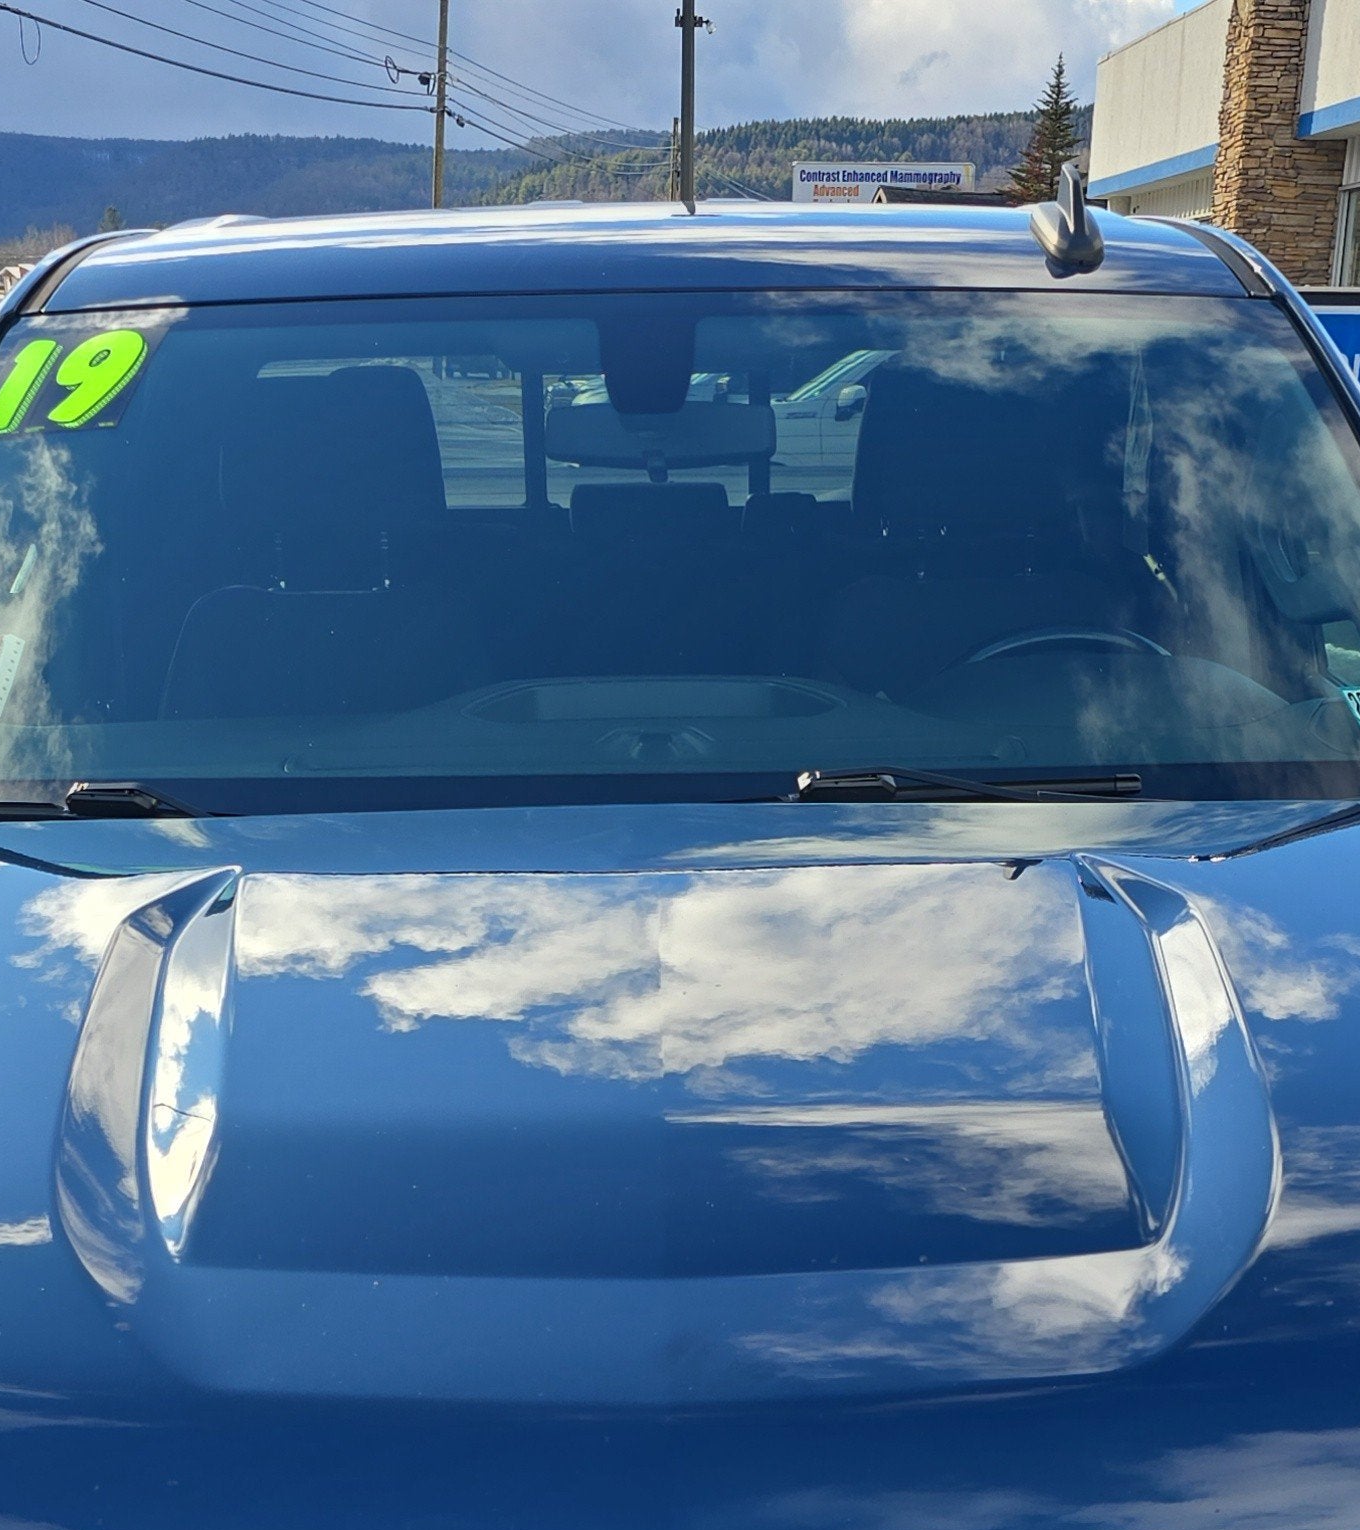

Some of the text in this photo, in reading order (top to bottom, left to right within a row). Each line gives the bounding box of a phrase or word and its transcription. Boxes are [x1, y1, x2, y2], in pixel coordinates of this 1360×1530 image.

[800, 169, 961, 185] Contrast Enhanced Mammography
[813, 184, 859, 197] Advanced
